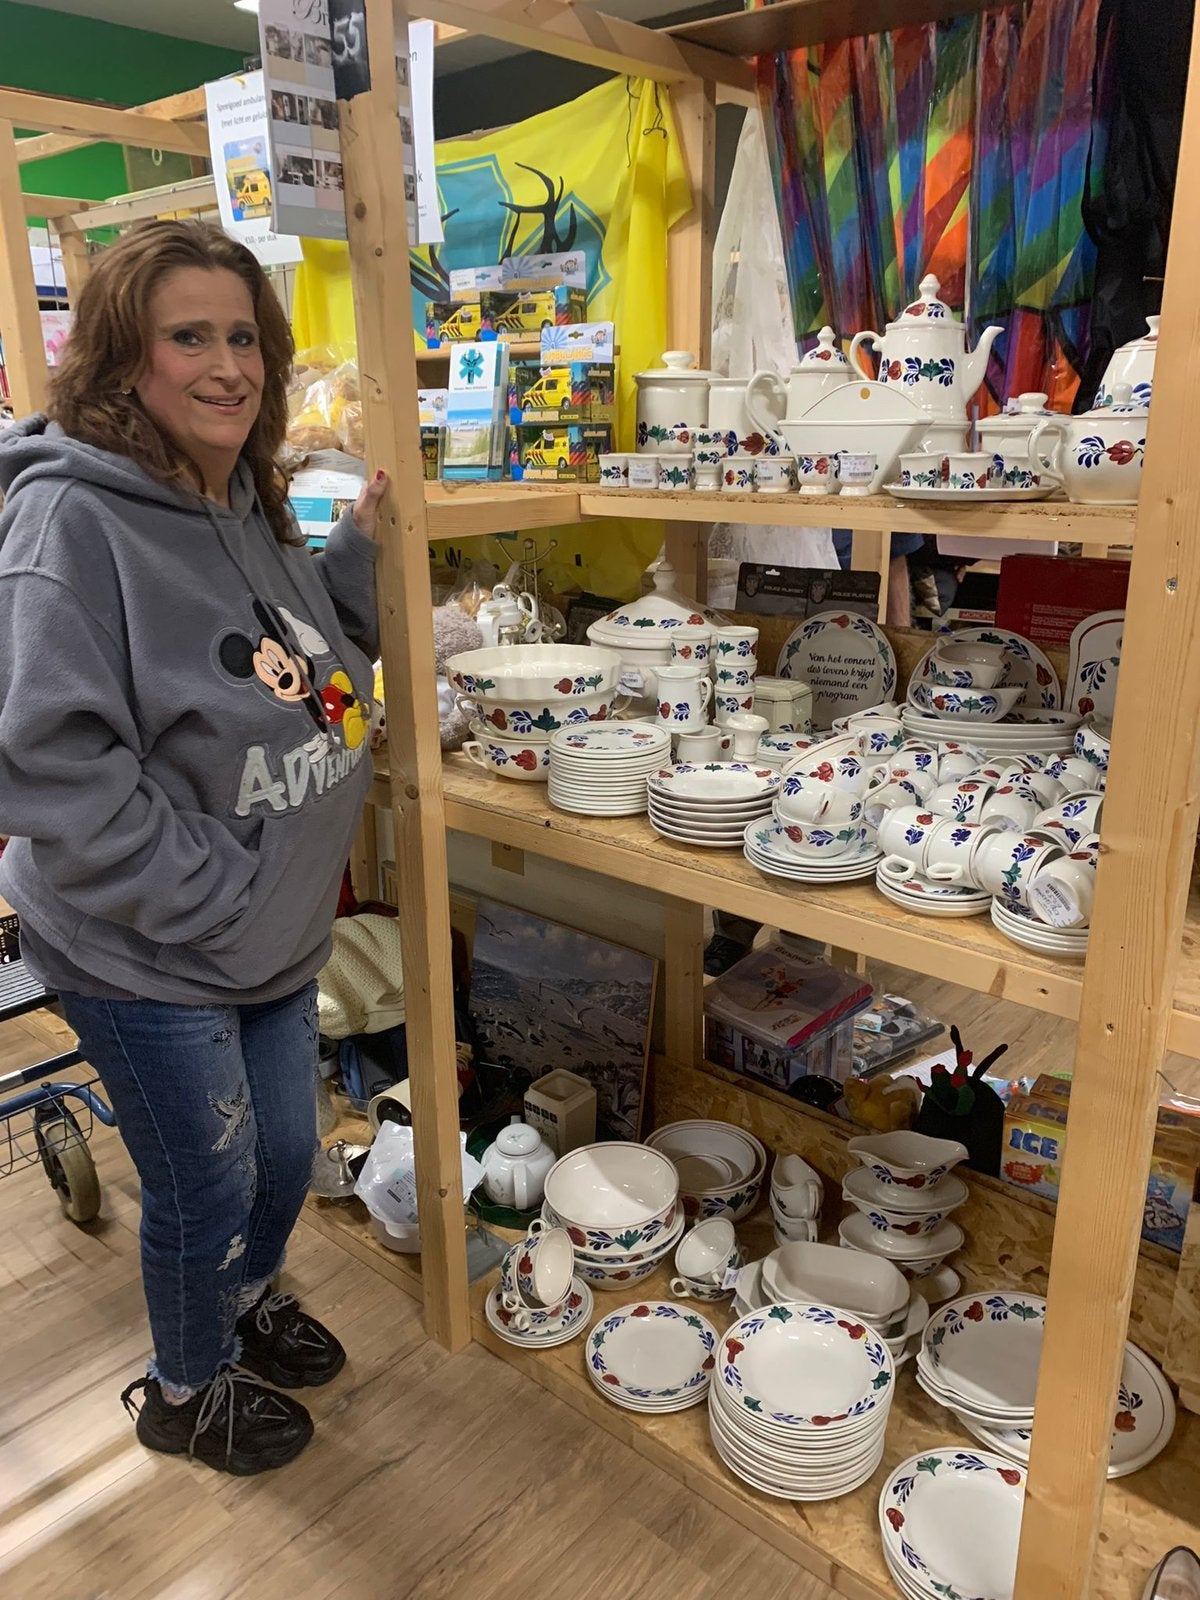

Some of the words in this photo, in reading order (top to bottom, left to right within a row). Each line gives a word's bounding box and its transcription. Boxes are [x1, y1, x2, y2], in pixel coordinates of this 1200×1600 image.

[809, 652, 825, 662] Van
[827, 653, 842, 663] het
[844, 657, 876, 666] concert
[807, 664, 821, 673] des
[822, 665, 849, 676] levens
[851, 667, 875, 681] krijgt
[810, 677, 850, 688] niemand
[851, 682, 869, 690] een
[816, 691, 859, 703] program
[1010, 1128, 1058, 1160] ICE
